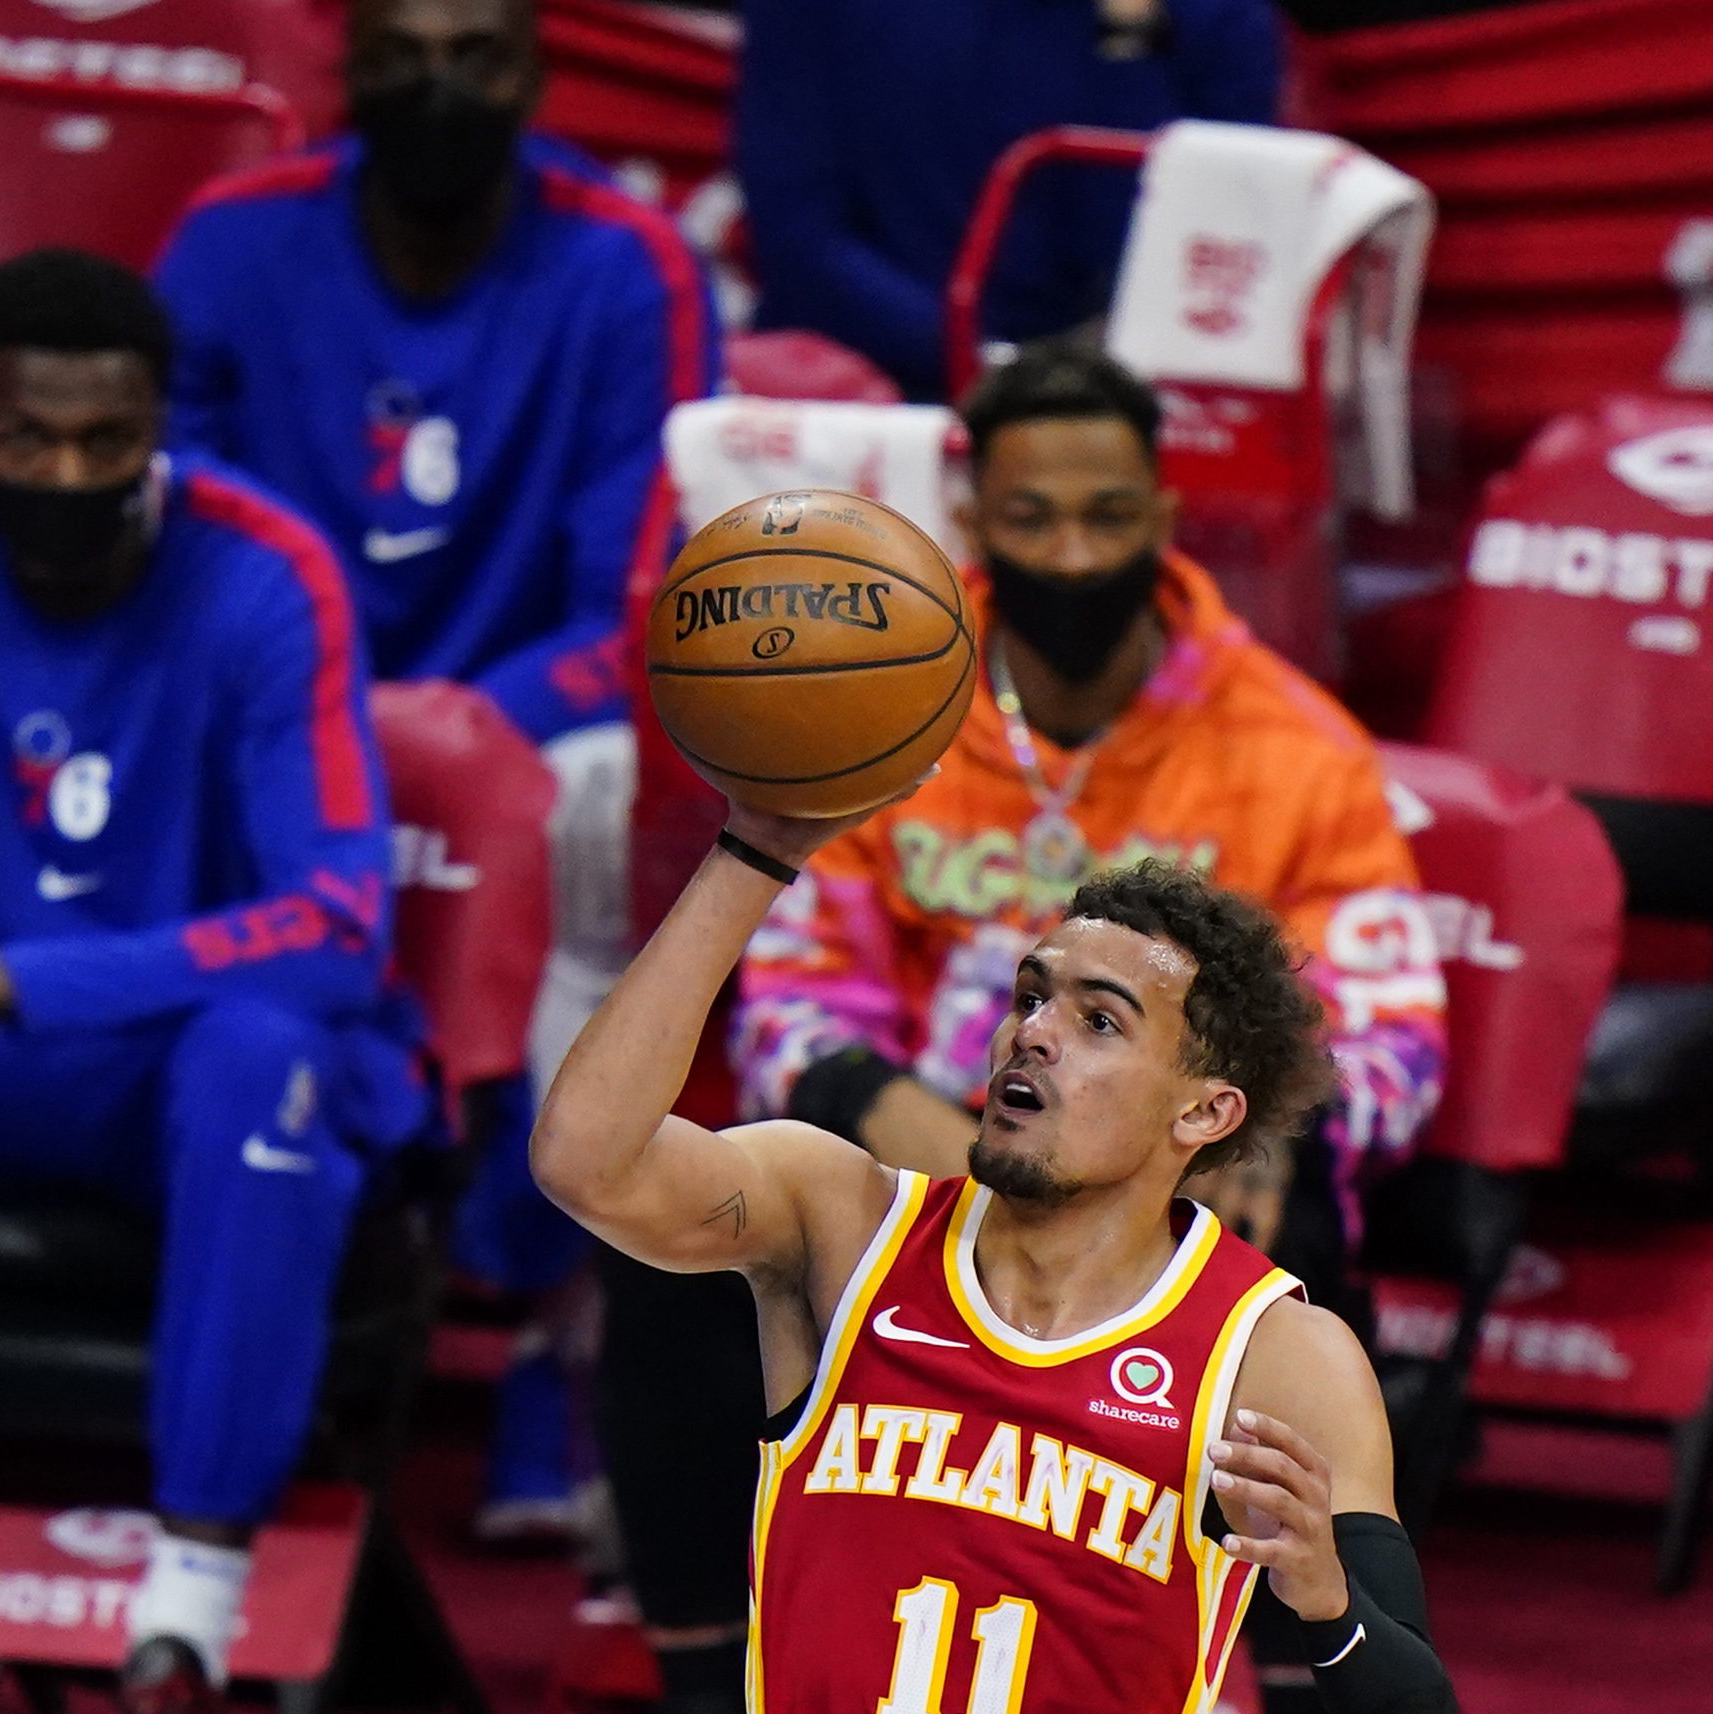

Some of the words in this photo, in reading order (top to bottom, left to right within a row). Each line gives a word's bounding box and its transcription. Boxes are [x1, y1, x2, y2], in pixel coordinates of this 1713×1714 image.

[675, 582, 890, 643] SPALDING
[1088, 1399, 1180, 1429] sharecare
[804, 1403, 1183, 1585] ATLANTA
